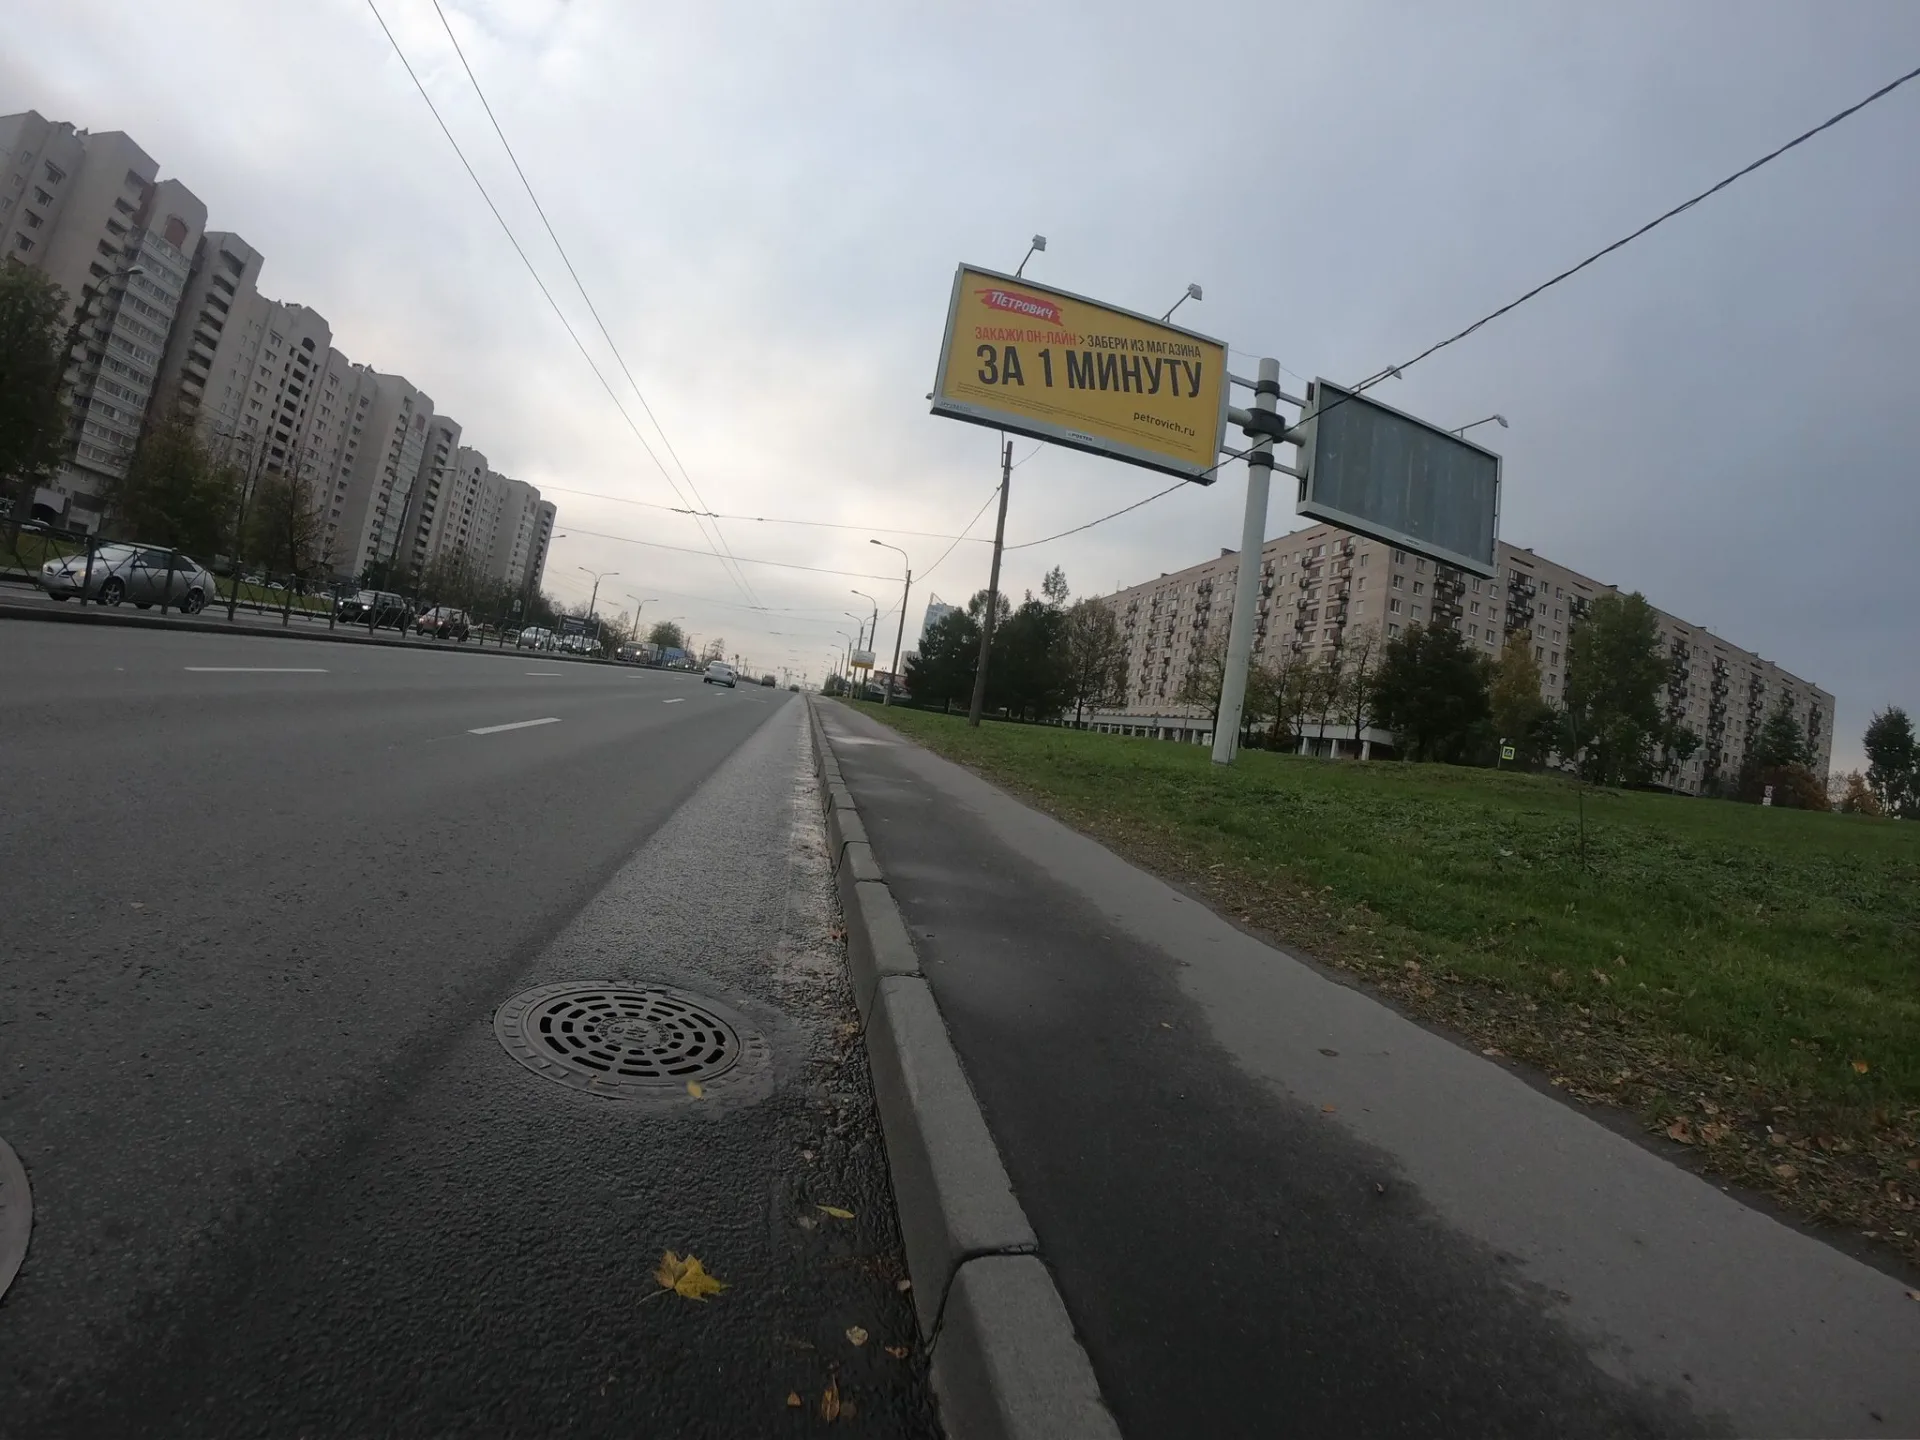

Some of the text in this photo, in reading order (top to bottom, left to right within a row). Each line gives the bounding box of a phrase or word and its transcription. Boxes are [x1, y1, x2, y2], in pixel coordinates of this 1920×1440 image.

[975, 326, 1202, 358] ЗАКАЖИ ОН-ЛАЙН ЗАБЕРИ ИЗ МАГАЗИНА
[976, 344, 1203, 399] ЗА 1 МИНУТУ
[1133, 410, 1196, 437] petrovich.ru
